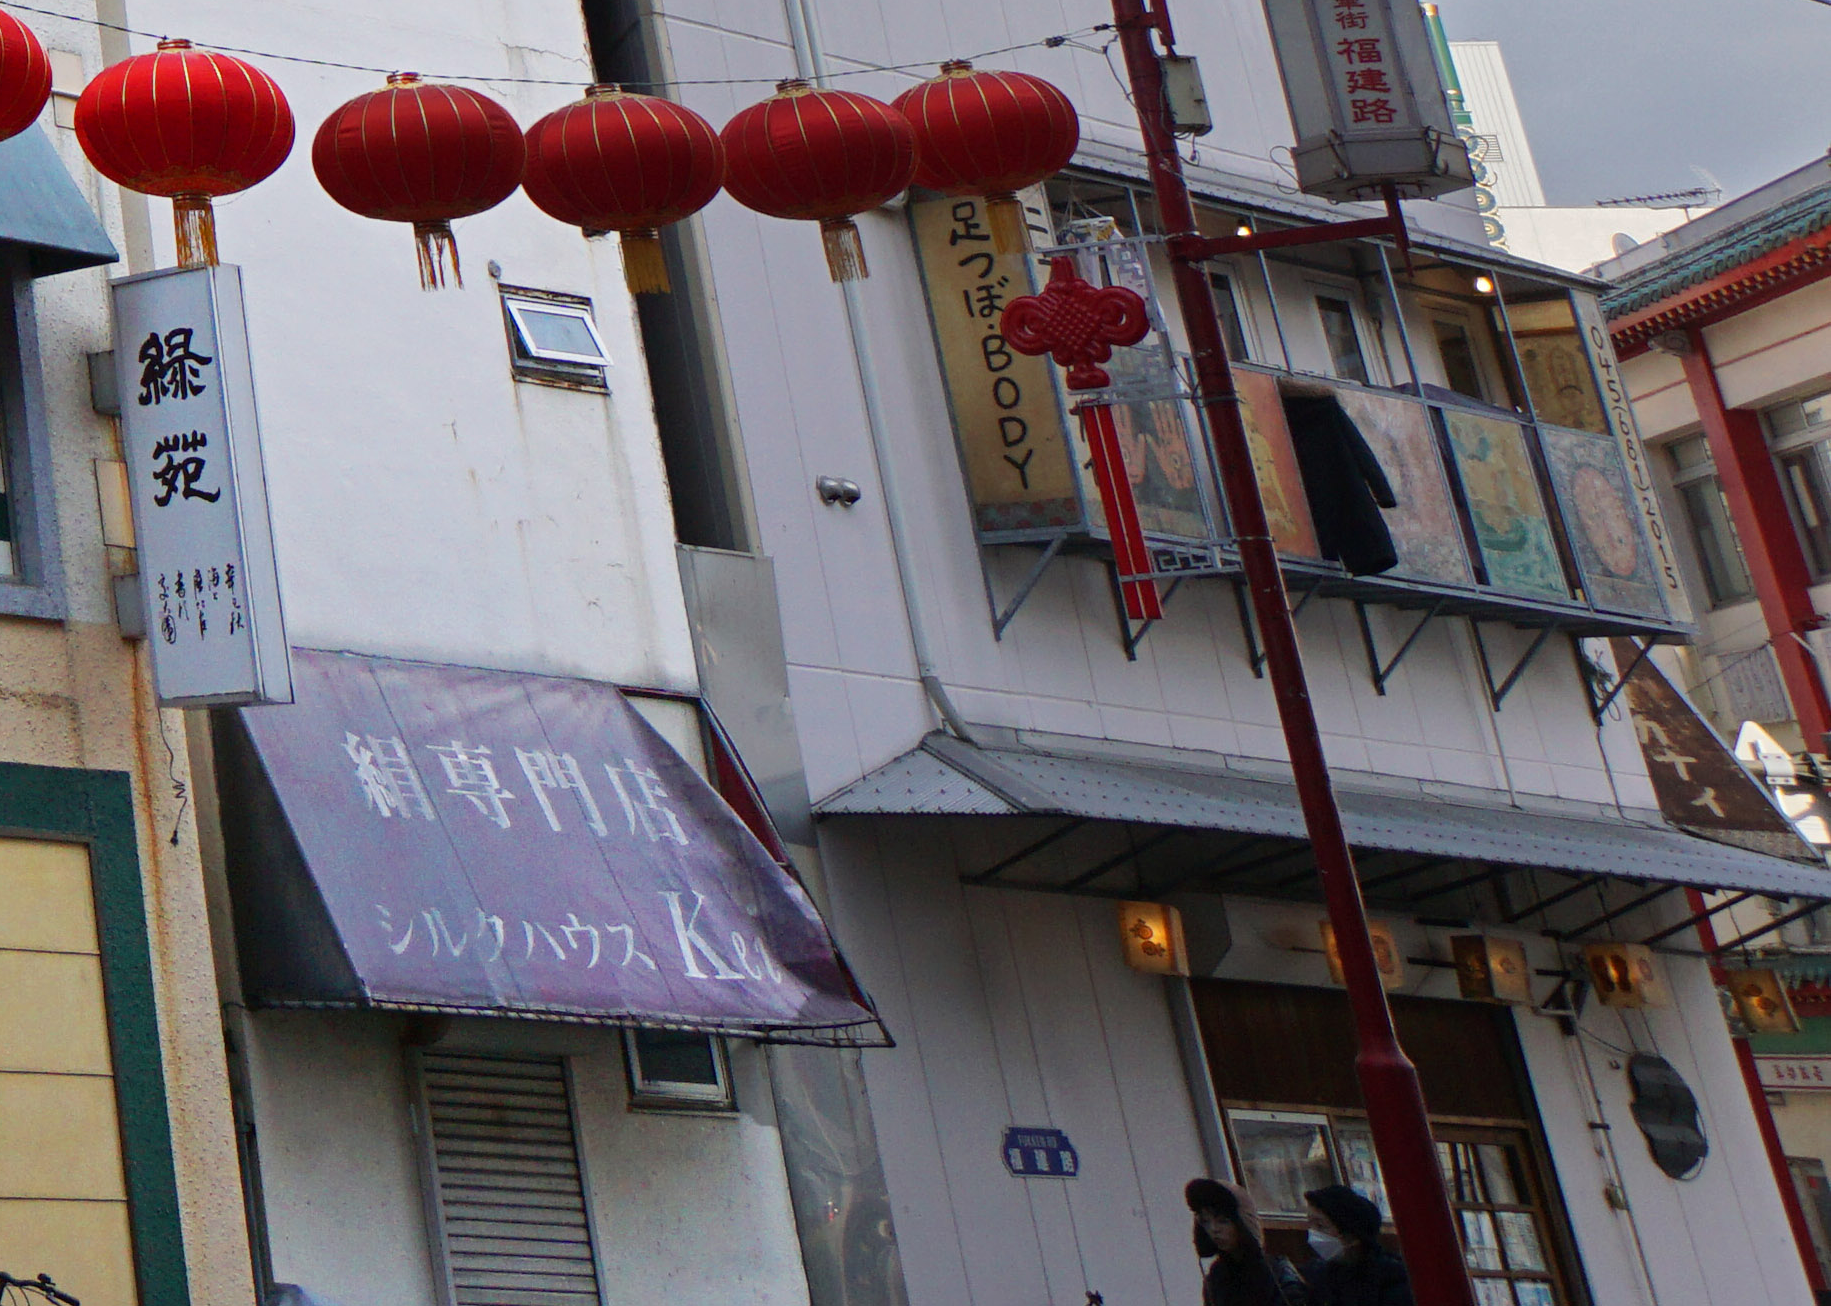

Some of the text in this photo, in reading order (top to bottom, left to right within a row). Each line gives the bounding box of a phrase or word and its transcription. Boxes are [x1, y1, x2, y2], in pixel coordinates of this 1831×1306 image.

[1336, 37, 1398, 124] 福建路
[342, 731, 689, 845] 絹専門店
[376, 890, 781, 985] シルクハウス Kei
